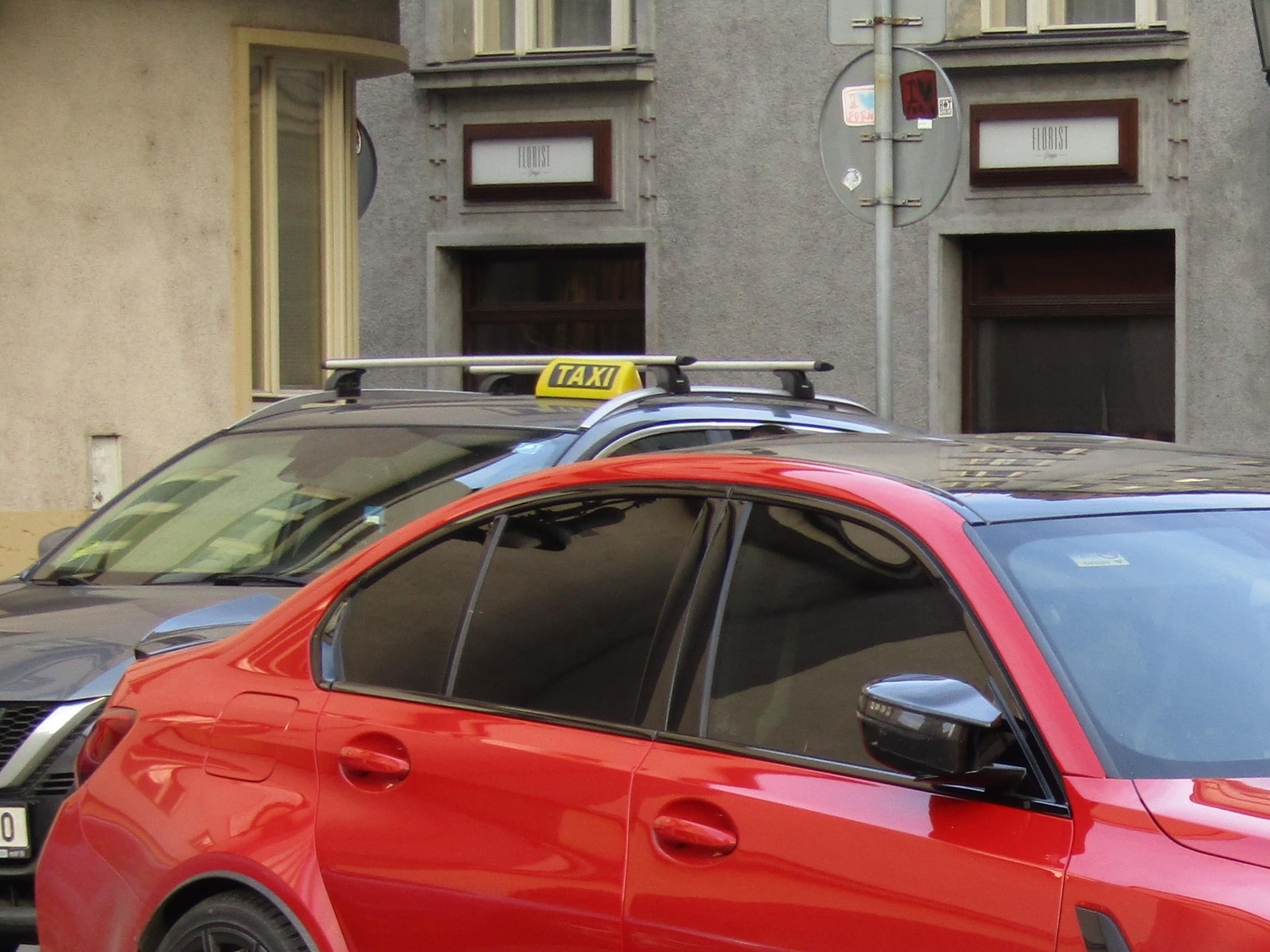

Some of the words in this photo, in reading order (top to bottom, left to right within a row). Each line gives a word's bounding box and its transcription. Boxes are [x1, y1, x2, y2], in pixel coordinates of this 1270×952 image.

[1032, 126, 1068, 151] FLORIST
[518, 145, 550, 168] FLORIST
[557, 365, 615, 387] TAXI
